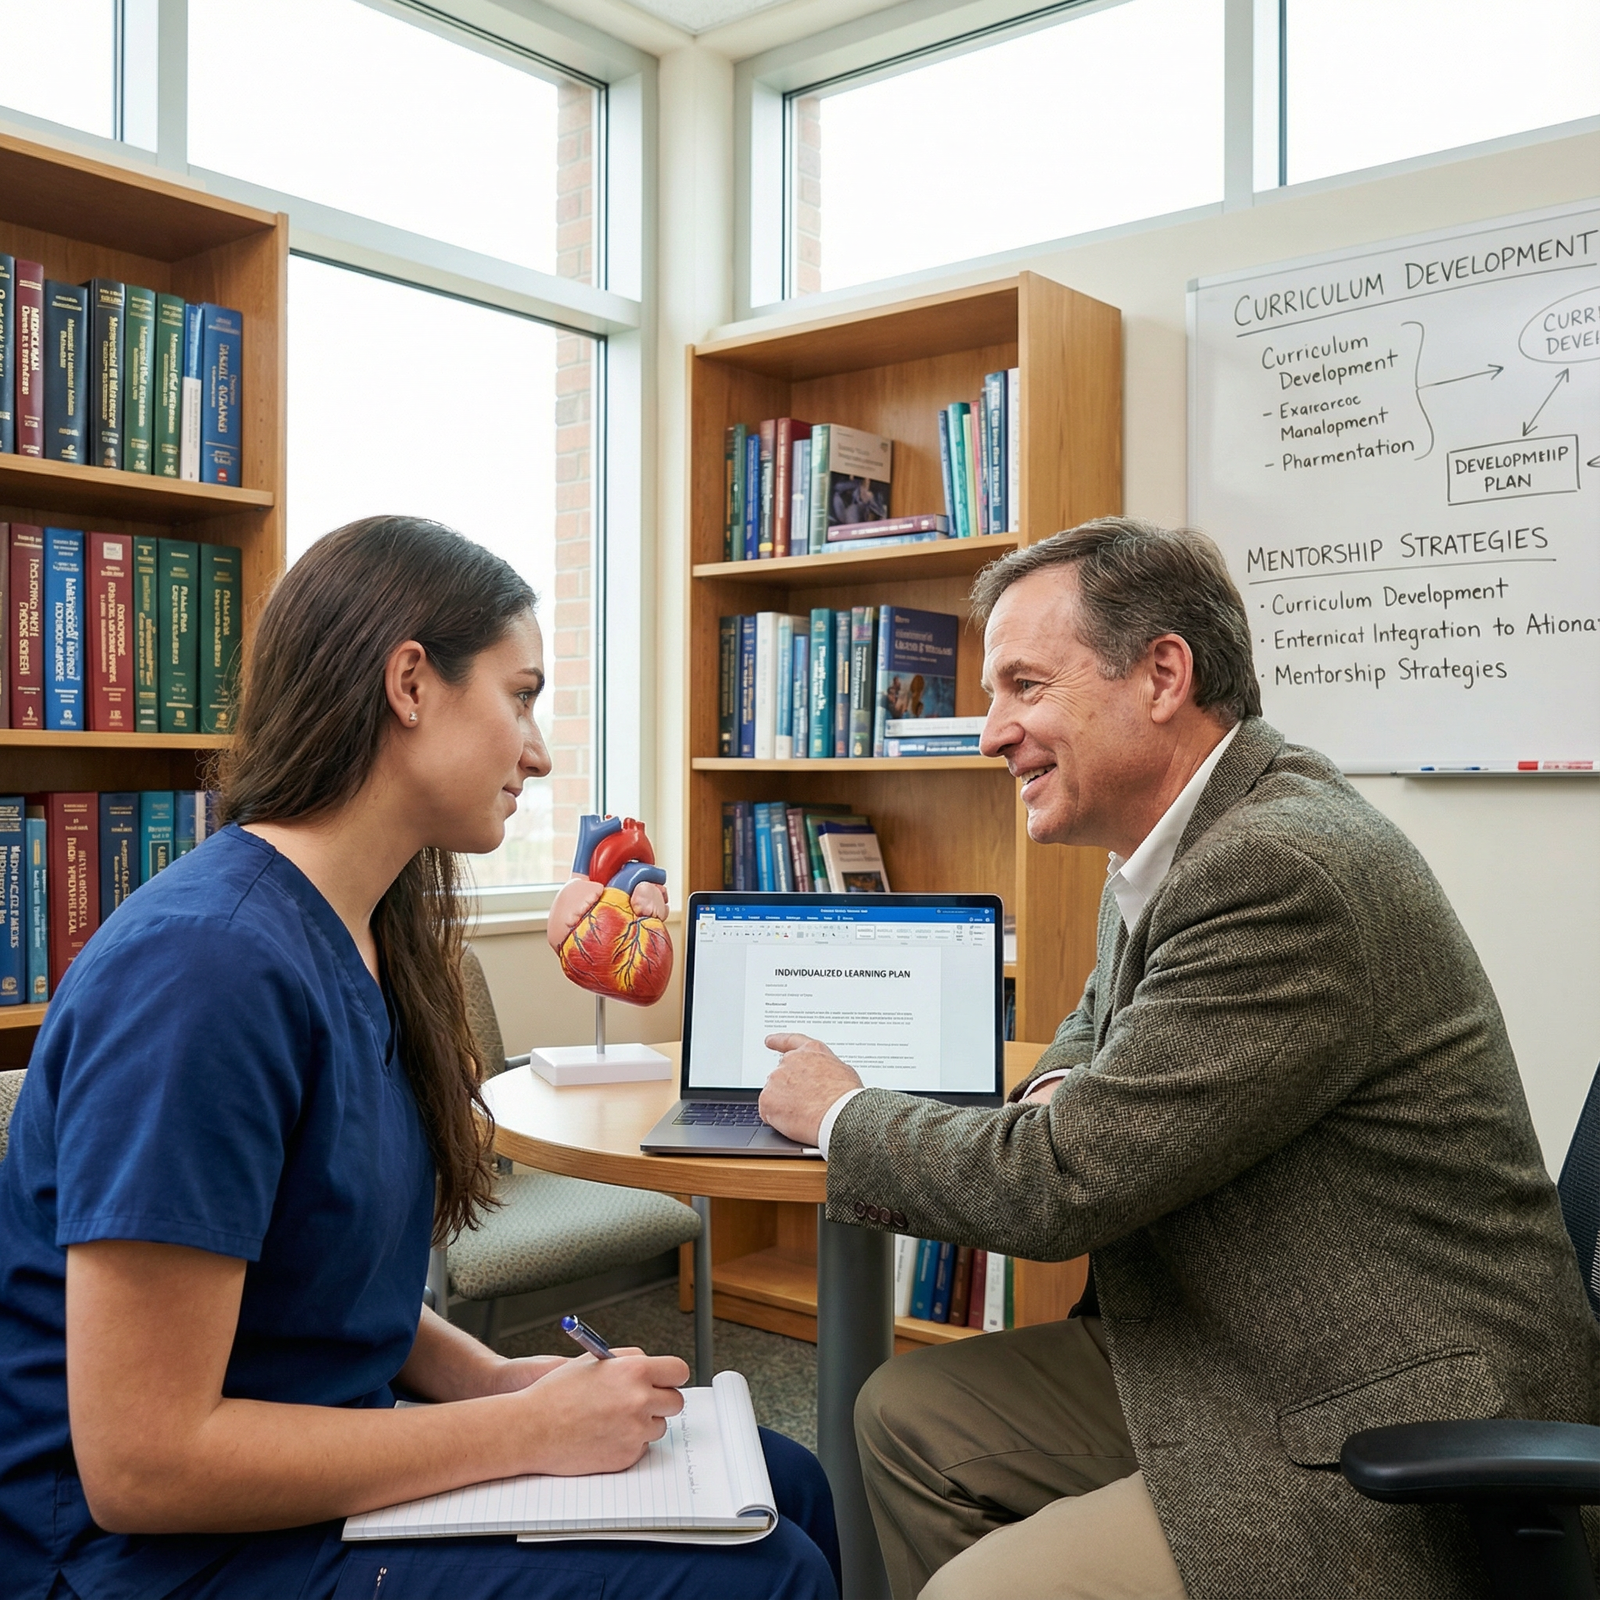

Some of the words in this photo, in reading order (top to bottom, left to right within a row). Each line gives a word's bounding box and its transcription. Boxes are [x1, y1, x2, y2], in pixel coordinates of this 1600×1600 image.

[1233, 273, 1385, 327] CURRICULUM
[1405, 230, 1600, 290] DEVELOPMENT
[1261, 335, 1369, 369] Curriculum
[1279, 349, 1399, 391] Development
[1280, 406, 1389, 442] Manalopment
[1282, 439, 1415, 472] Pharmentation
[1484, 473, 1532, 493] PLAN
[1247, 539, 1384, 574] MENTORSHIP
[1400, 527, 1549, 559] STRATEGIES
[1271, 591, 1373, 616] Curriculum
[1383, 577, 1510, 610] Development
[1373, 620, 1482, 651] Integration
[1493, 616, 1515, 637] to
[1526, 612, 1600, 635] Ationa
[1275, 662, 1387, 689] Mentorship
[1398, 656, 1508, 689] Strategies
[774, 968, 843, 978] INDIVIDUALIZED
[844, 969, 887, 979] LEARNING
[888, 970, 911, 979] PLAN
